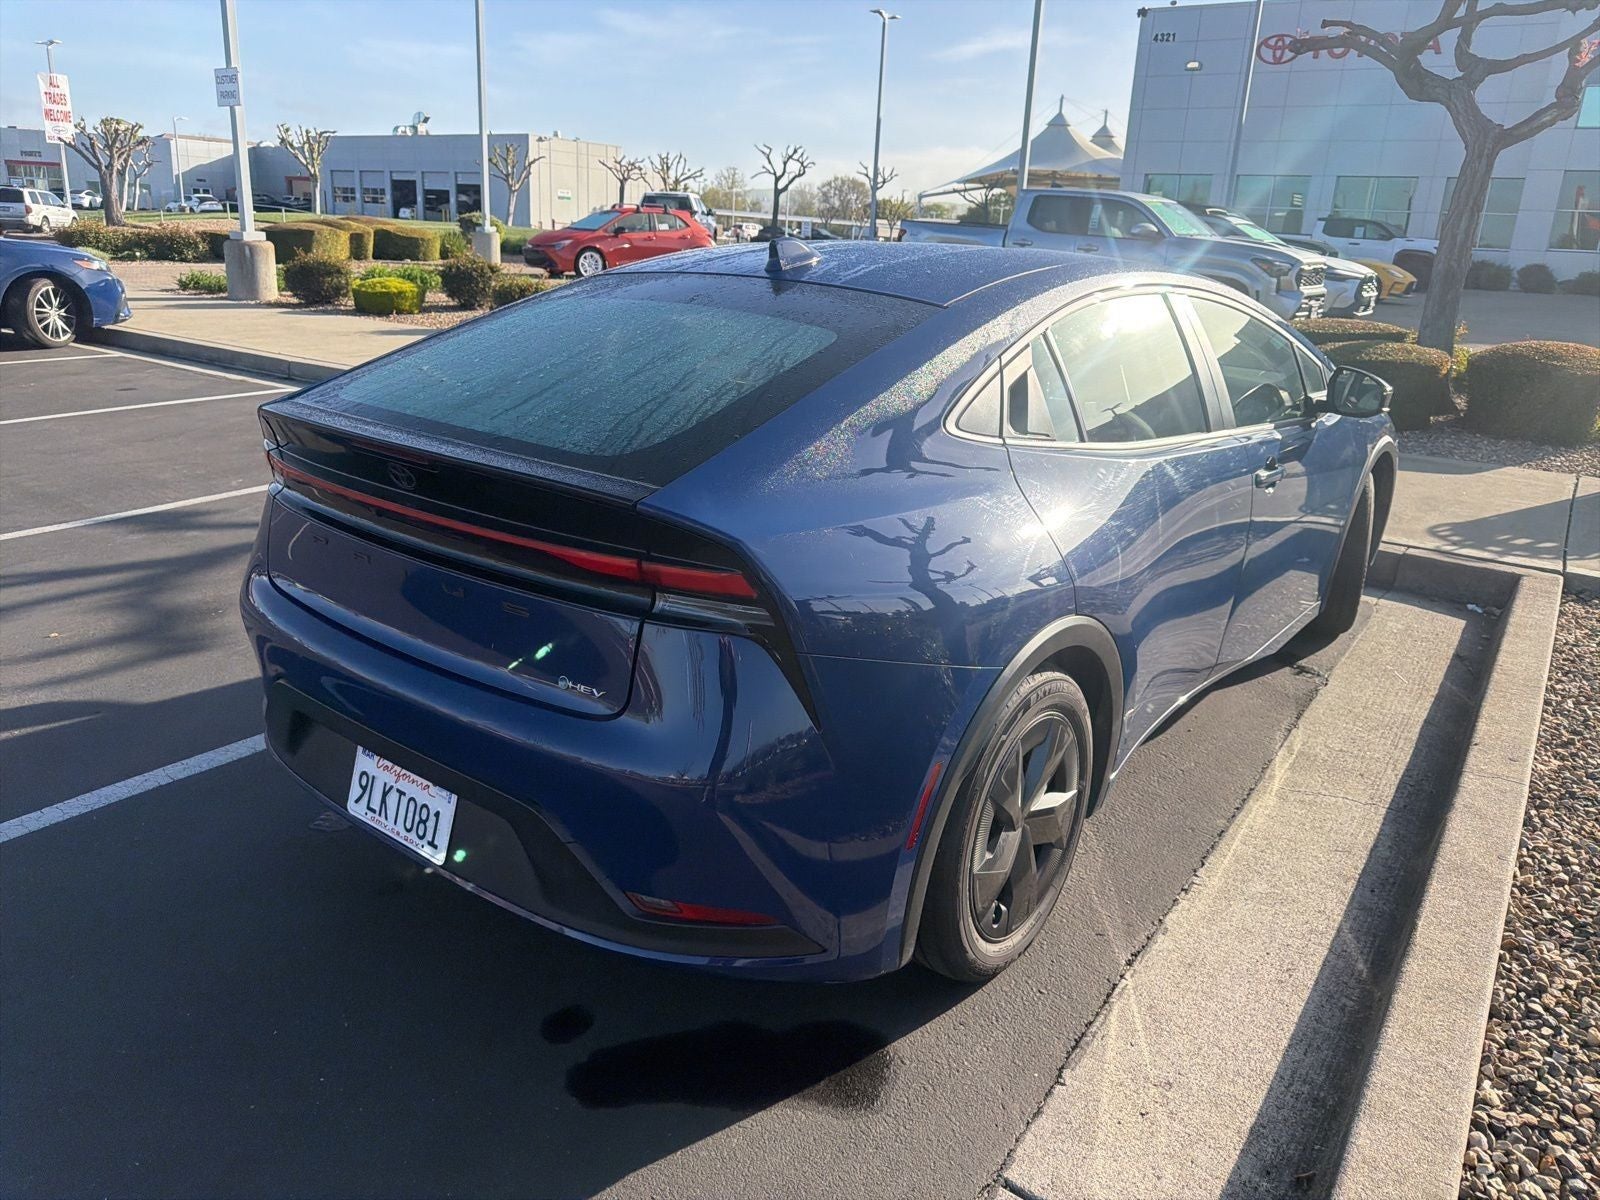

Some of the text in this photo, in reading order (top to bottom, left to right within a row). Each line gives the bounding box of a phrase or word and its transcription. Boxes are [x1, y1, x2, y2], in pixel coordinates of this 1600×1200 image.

[1153, 32, 1176, 43] 4321
[49, 74, 60, 89] ALL
[44, 91, 67, 106] TRADES
[44, 108, 72, 123] WELCOME
[375, 756, 436, 799] California
[354, 770, 441, 850] 9LKT081
[370, 814, 420, 848] dmv.ca.gov
